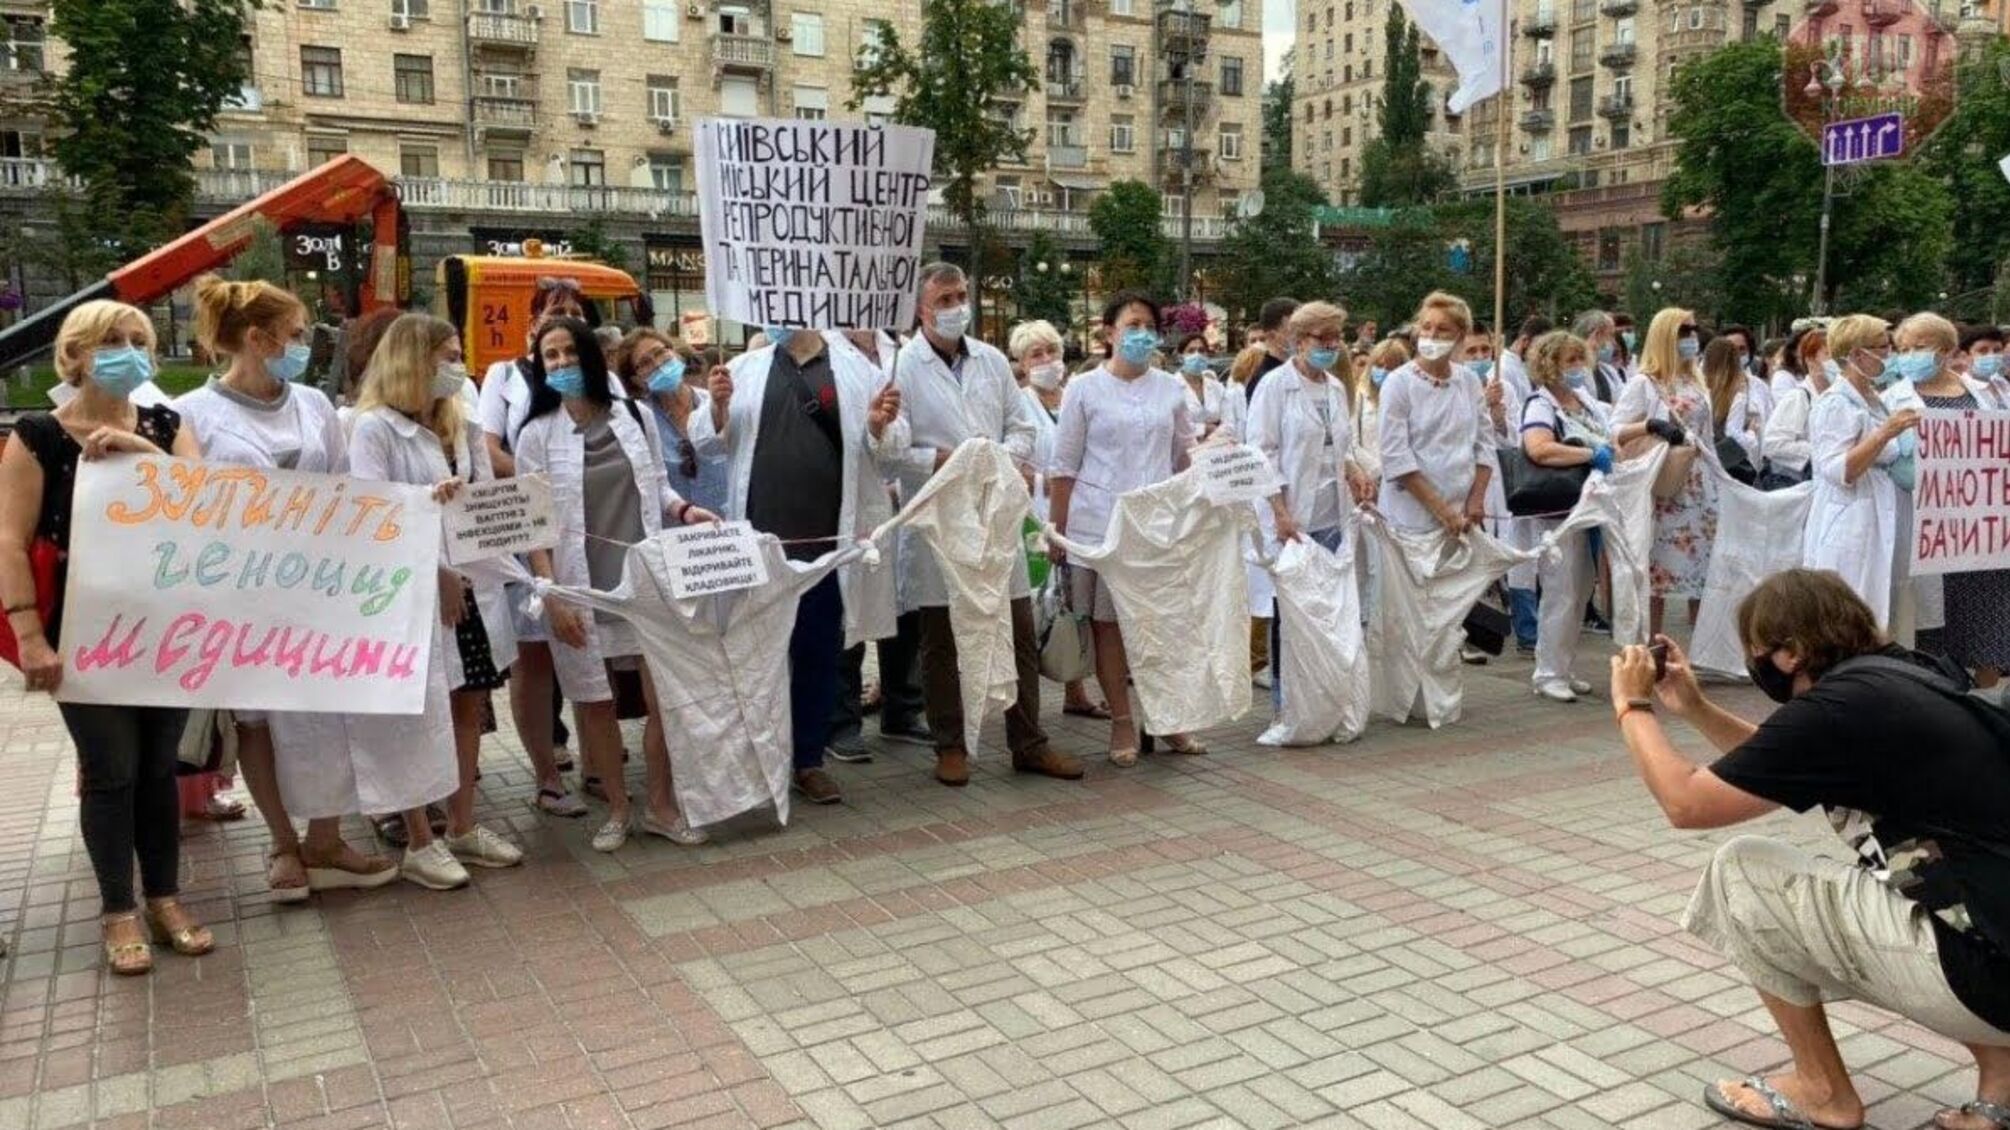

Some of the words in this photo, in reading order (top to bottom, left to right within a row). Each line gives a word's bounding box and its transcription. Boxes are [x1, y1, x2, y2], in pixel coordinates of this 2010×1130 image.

[716, 122, 885, 168] КИЇВСЬКИЙ
[719, 162, 830, 203] МІСЬКИЙ
[851, 170, 930, 208] ЦЕНТР
[722, 200, 918, 248] РЕПРОДУКТИВНОЇ
[718, 241, 742, 283] ТА
[745, 247, 919, 294] ПЕРИНАТАЛЬНОЇ
[482, 304, 509, 325] 24
[748, 288, 900, 330] МЕДИЦИНИ
[490, 326, 505, 347] h
[681, 557, 754, 576] ВІДКРИВАЙТЕ
